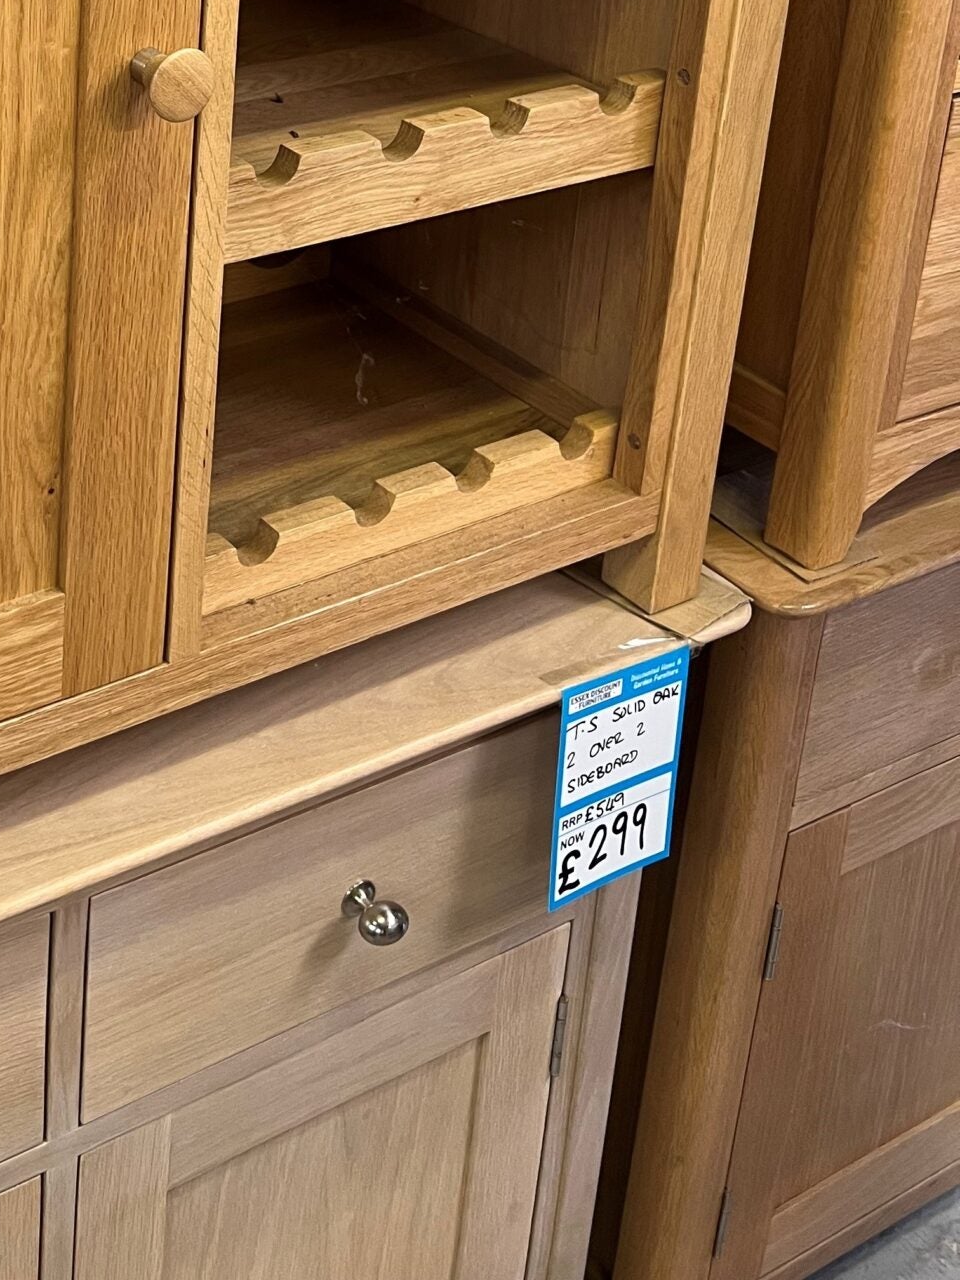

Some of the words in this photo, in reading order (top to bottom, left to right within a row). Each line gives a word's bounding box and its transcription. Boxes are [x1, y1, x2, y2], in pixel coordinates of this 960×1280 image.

[570, 694, 590, 706] ESSEX
[591, 681, 621, 697] DISCOUNT
[578, 692, 611, 709] FURNITURE
[612, 699, 646, 722] SOLID
[653, 684, 680, 705] OAK
[566, 751, 576, 769] 2
[589, 731, 624, 758] OVER
[636, 722, 646, 736] 2
[567, 749, 638, 793] SIDEBOARD
[561, 813, 583, 831] RRP
[585, 792, 624, 823] £549
[558, 803, 647, 895] £299
[560, 831, 585, 850] NOW
